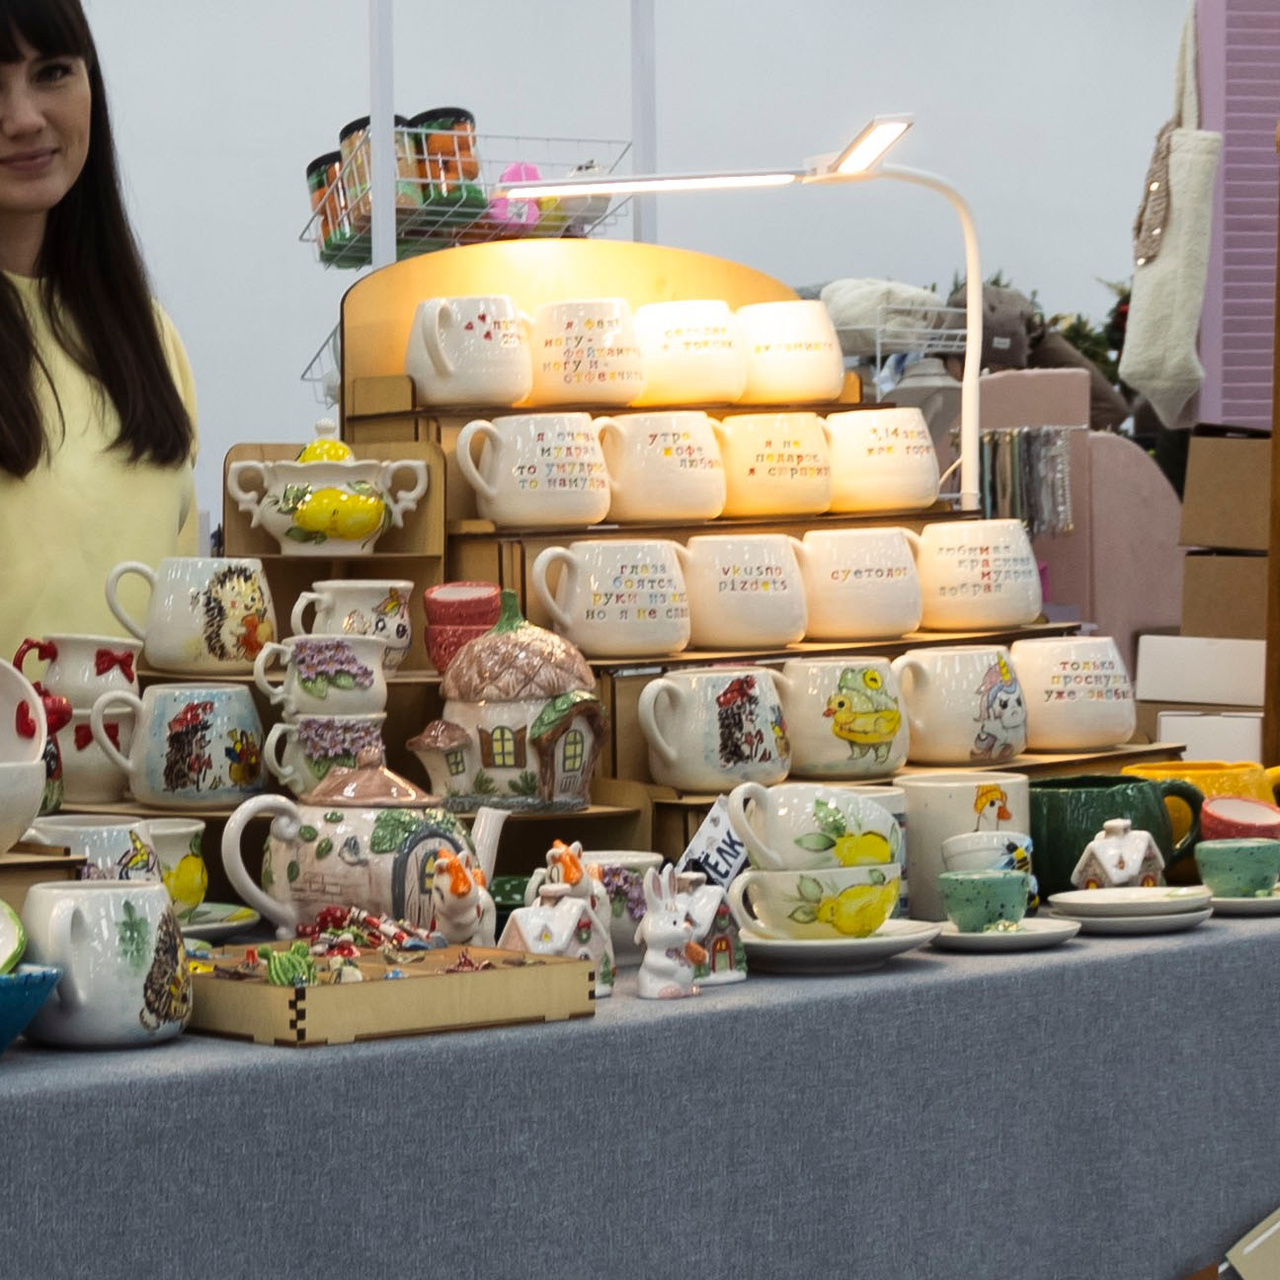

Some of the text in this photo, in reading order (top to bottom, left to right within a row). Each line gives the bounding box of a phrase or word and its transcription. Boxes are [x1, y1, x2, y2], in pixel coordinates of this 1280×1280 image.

[648, 431, 690, 447] утро
[721, 563, 783, 578] vkusno
[718, 578, 789, 593] pizdets
[592, 592, 638, 607] руки
[586, 608, 607, 621] но
[620, 609, 628, 621] я
[637, 607, 657, 621] не
[1044, 689, 1077, 703] уже
[699, 828, 745, 880] ЁЛК
